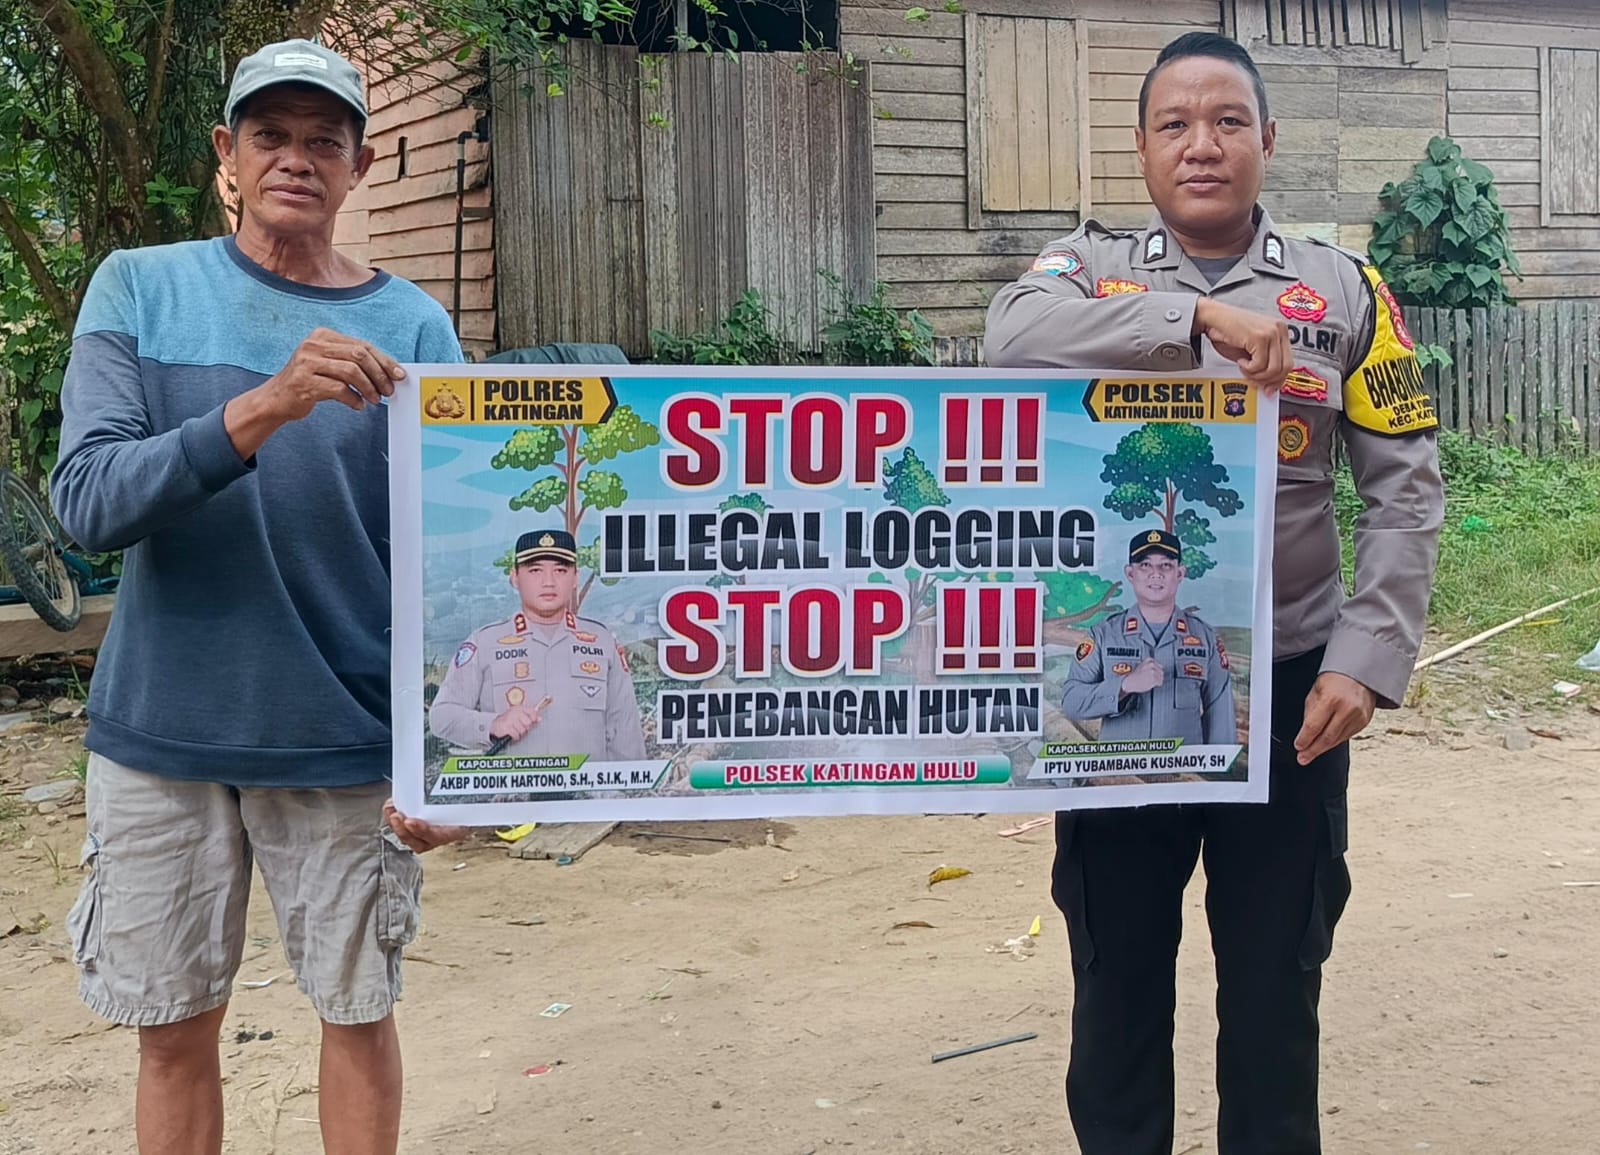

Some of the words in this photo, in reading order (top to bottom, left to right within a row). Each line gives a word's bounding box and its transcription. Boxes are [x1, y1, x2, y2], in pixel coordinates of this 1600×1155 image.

[1288, 325, 1337, 354] OLRI
[484, 380, 583, 402] POLRES
[1104, 383, 1204, 403] POLSEK
[484, 404, 583, 420] KATINGAN
[1104, 406, 1168, 420] KATINGAN
[1171, 405, 1204, 419] HULU
[666, 397, 907, 486] STOP
[944, 398, 1038, 483] !!!
[605, 512, 829, 573] ILLEGAL
[845, 509, 1095, 569] LOGGING
[665, 588, 904, 676] STOP
[943, 587, 1037, 669] !!!
[495, 648, 528, 660] DODIK
[572, 645, 604, 657] POLRI
[661, 690, 908, 739] PENEBANGAN
[919, 687, 1040, 735] HUTAN
[1047, 744, 1097, 755] KAPOLSEK
[1100, 743, 1147, 753] KATINGAN
[1149, 740, 1174, 750] HULU
[458, 759, 513, 769] KAPOLRES
[515, 758, 568, 768] KATINGAN
[725, 764, 806, 782] POLSEK
[813, 762, 916, 780] KATINGAN
[923, 761, 977, 779] HULU
[1044, 761, 1072, 774] IPTU
[1074, 758, 1147, 773] YUBAMBANG
[1150, 755, 1207, 770] KUSNADY,
[1210, 755, 1226, 767] SH
[440, 776, 470, 790] AKBP
[473, 775, 508, 789] DODIK
[511, 774, 567, 789] HARTONO,
[570, 772, 594, 787] S.H.,
[597, 771, 628, 786] S.I.K.,
[630, 770, 654, 784] M.H.
